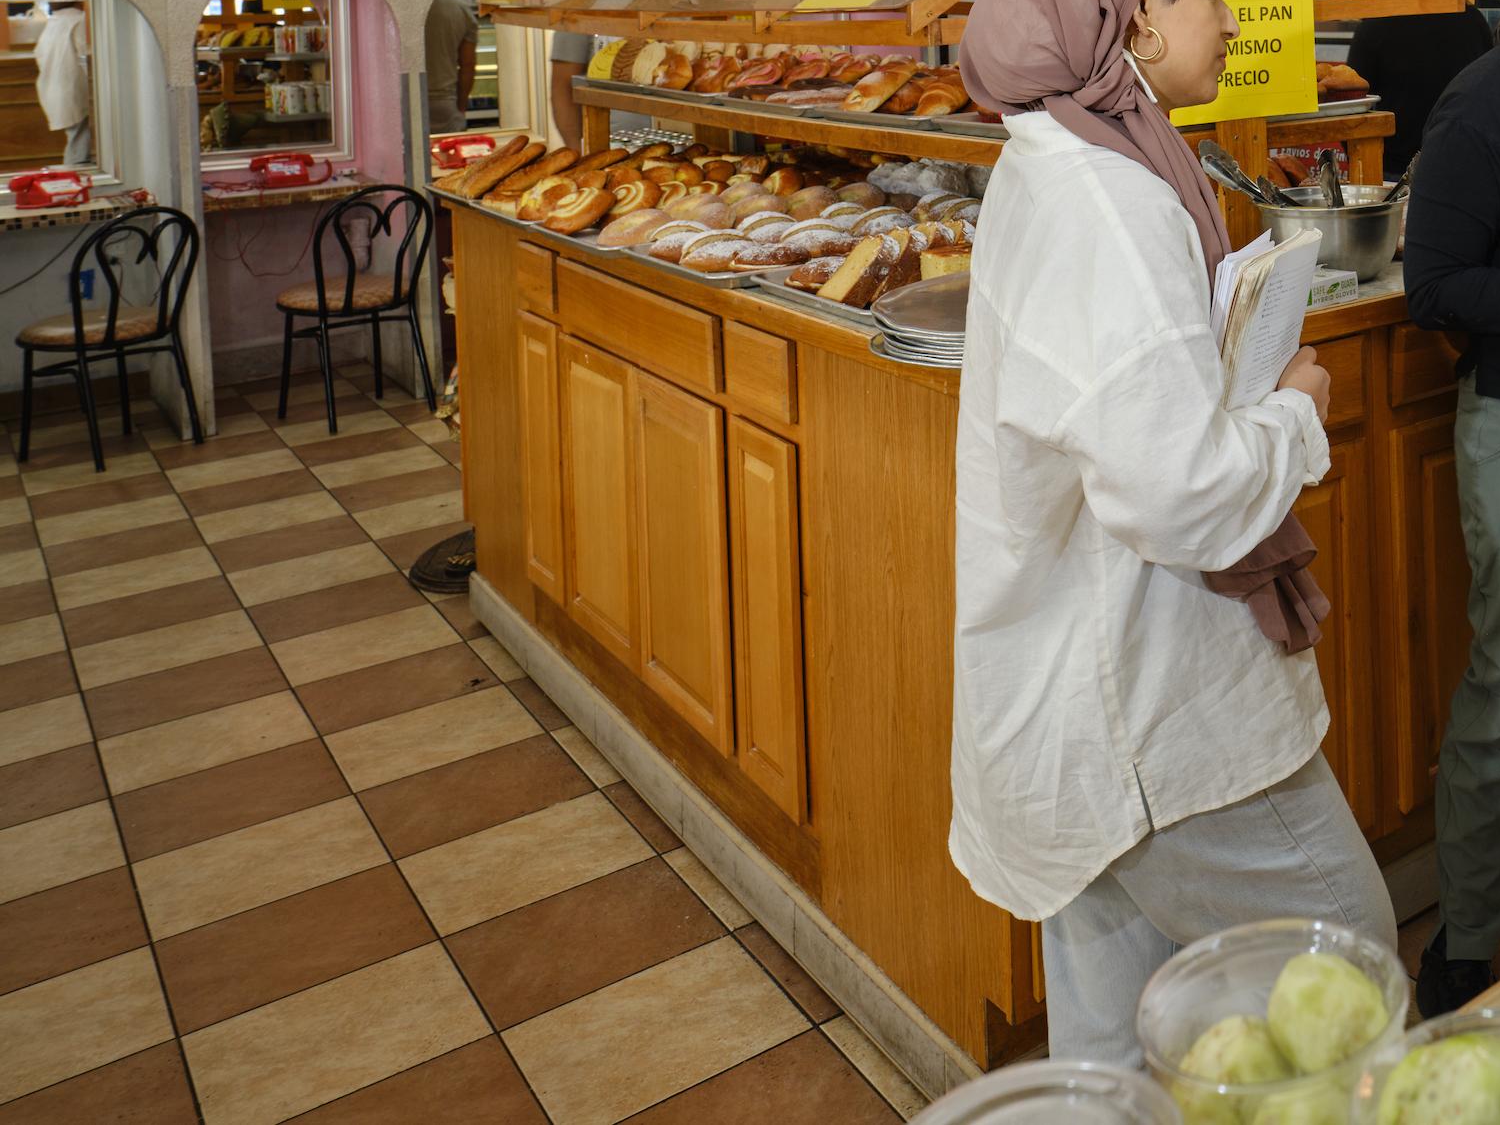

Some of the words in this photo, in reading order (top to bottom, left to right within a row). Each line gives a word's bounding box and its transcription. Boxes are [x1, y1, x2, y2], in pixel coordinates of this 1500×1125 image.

[1239, 7, 1255, 22] EL
[1260, 5, 1293, 21] PAN
[1225, 38, 1282, 56] MISMO
